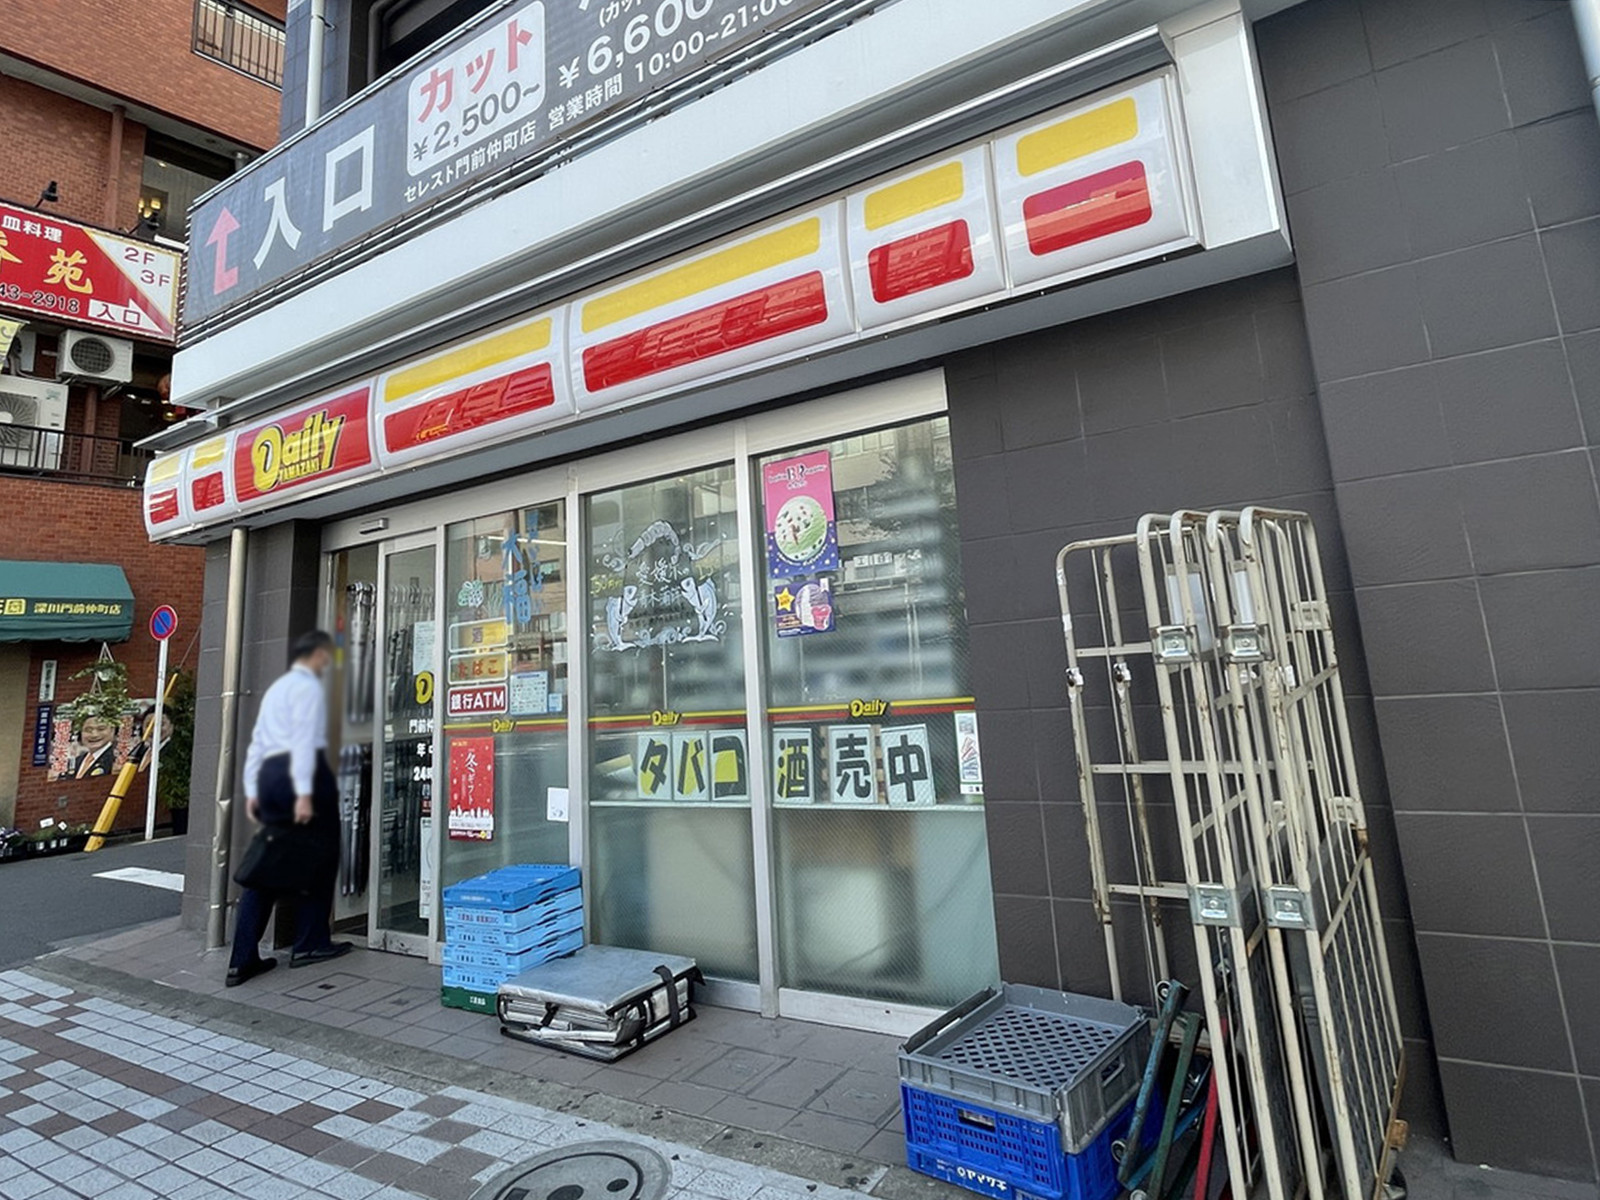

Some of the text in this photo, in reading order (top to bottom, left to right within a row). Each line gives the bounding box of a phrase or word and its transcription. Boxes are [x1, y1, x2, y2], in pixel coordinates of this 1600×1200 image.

[418, 19, 533, 123] カット
[403, 120, 536, 203] セレスト門前仲町店
[547, 73, 624, 131] 営業時間
[254, 125, 375, 270] 入口
[2, 215, 63, 244] 皿料理
[124, 247, 156, 264] 2F
[140, 270, 171, 287] 3F
[97, 304, 140, 325] 入口
[252, 410, 346, 491] Daily
[457, 659, 498, 678] たばこ
[450, 691, 505, 711] 銀行ATM
[850, 699, 891, 718] Daily
[640, 735, 747, 799] タバコ
